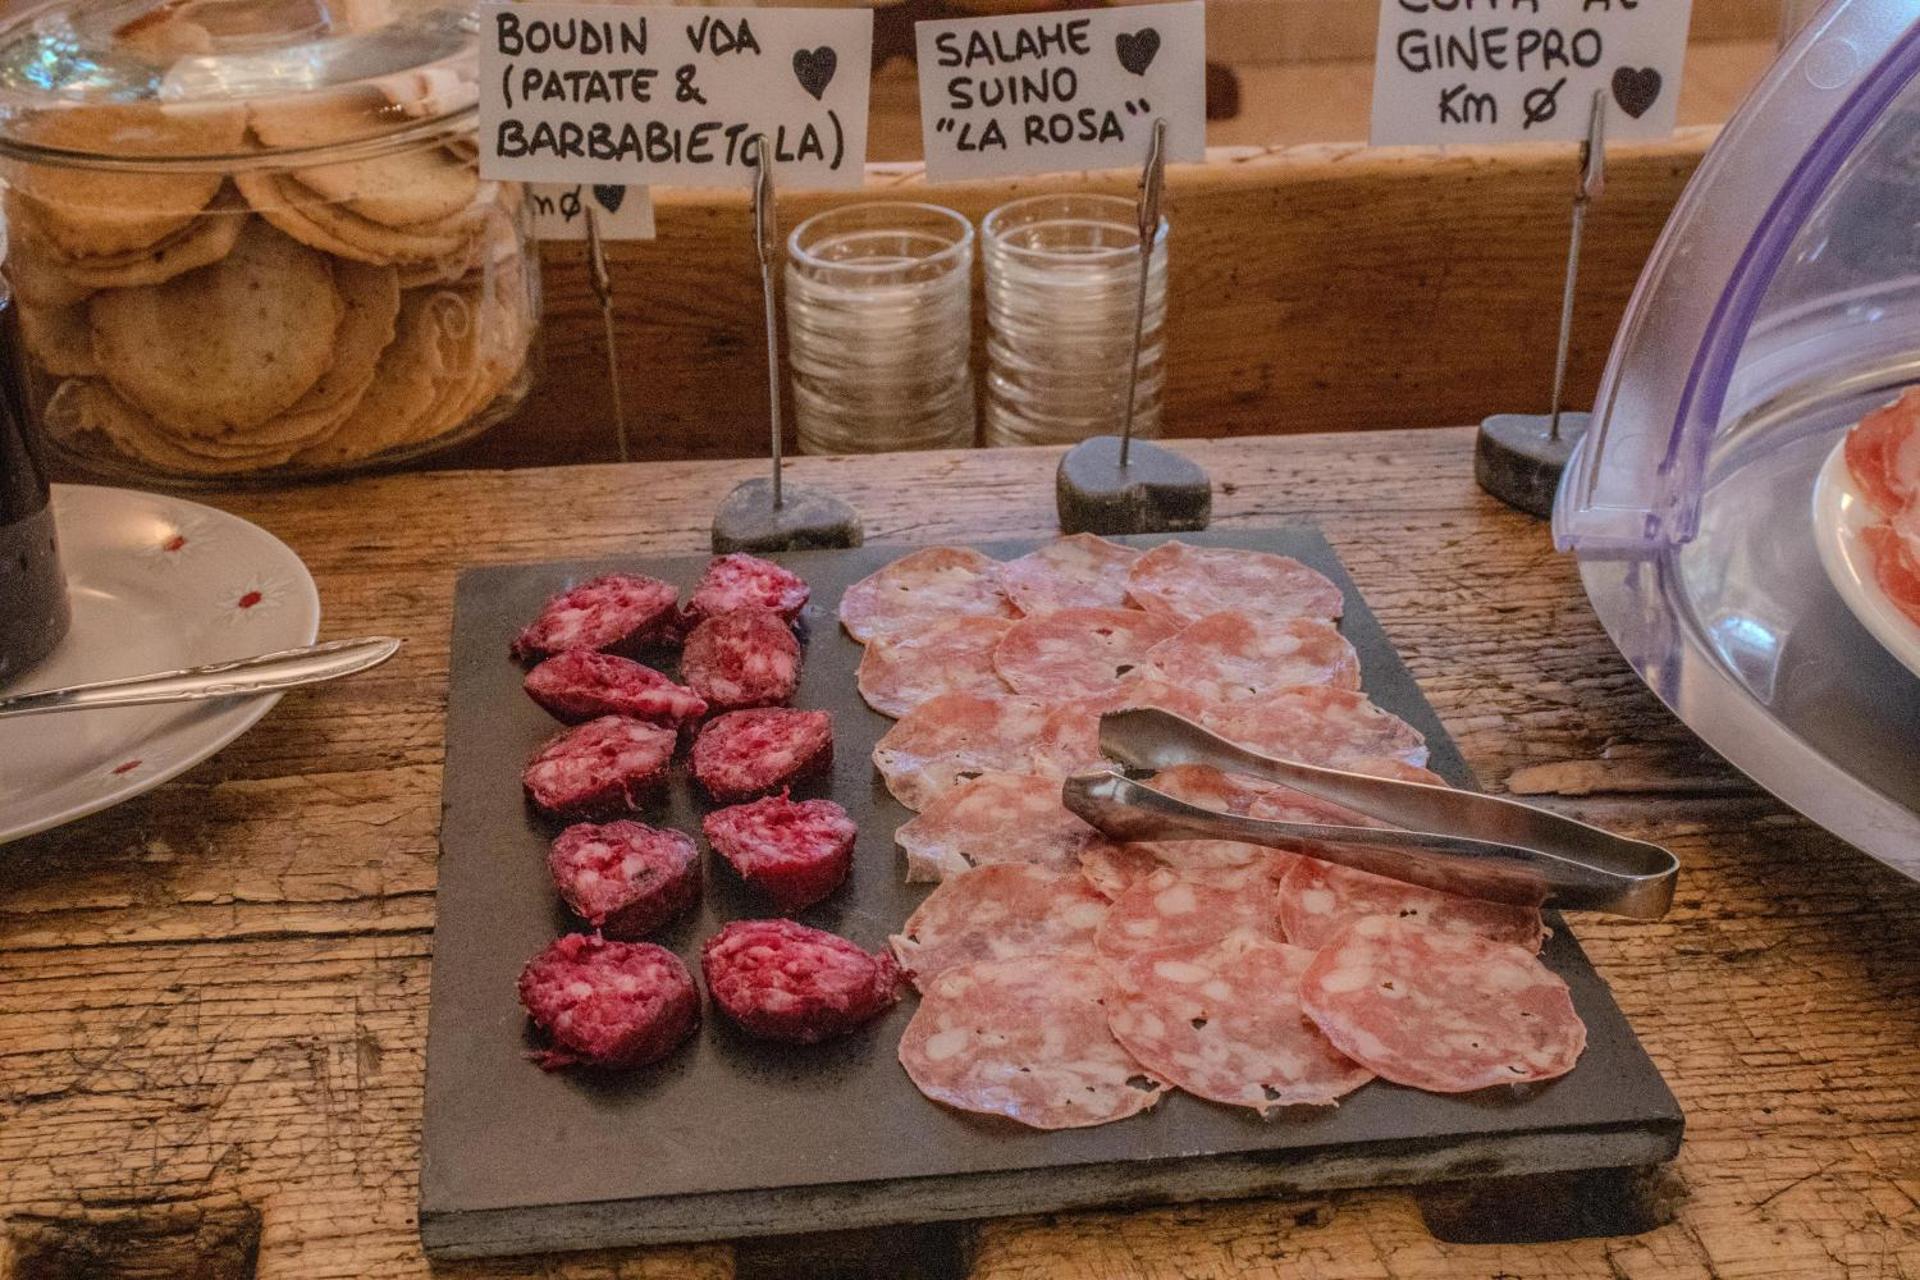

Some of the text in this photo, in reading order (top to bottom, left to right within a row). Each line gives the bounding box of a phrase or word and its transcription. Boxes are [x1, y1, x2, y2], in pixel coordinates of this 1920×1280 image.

[496, 12, 761, 56] BOUDIN VDA
[1396, 26, 1602, 73] GINEPRO
[502, 63, 707, 109] (PATATE &
[947, 66, 1077, 109] SUINO
[1439, 83, 1498, 124] Km
[936, 98, 1151, 152] "LA ROSA"
